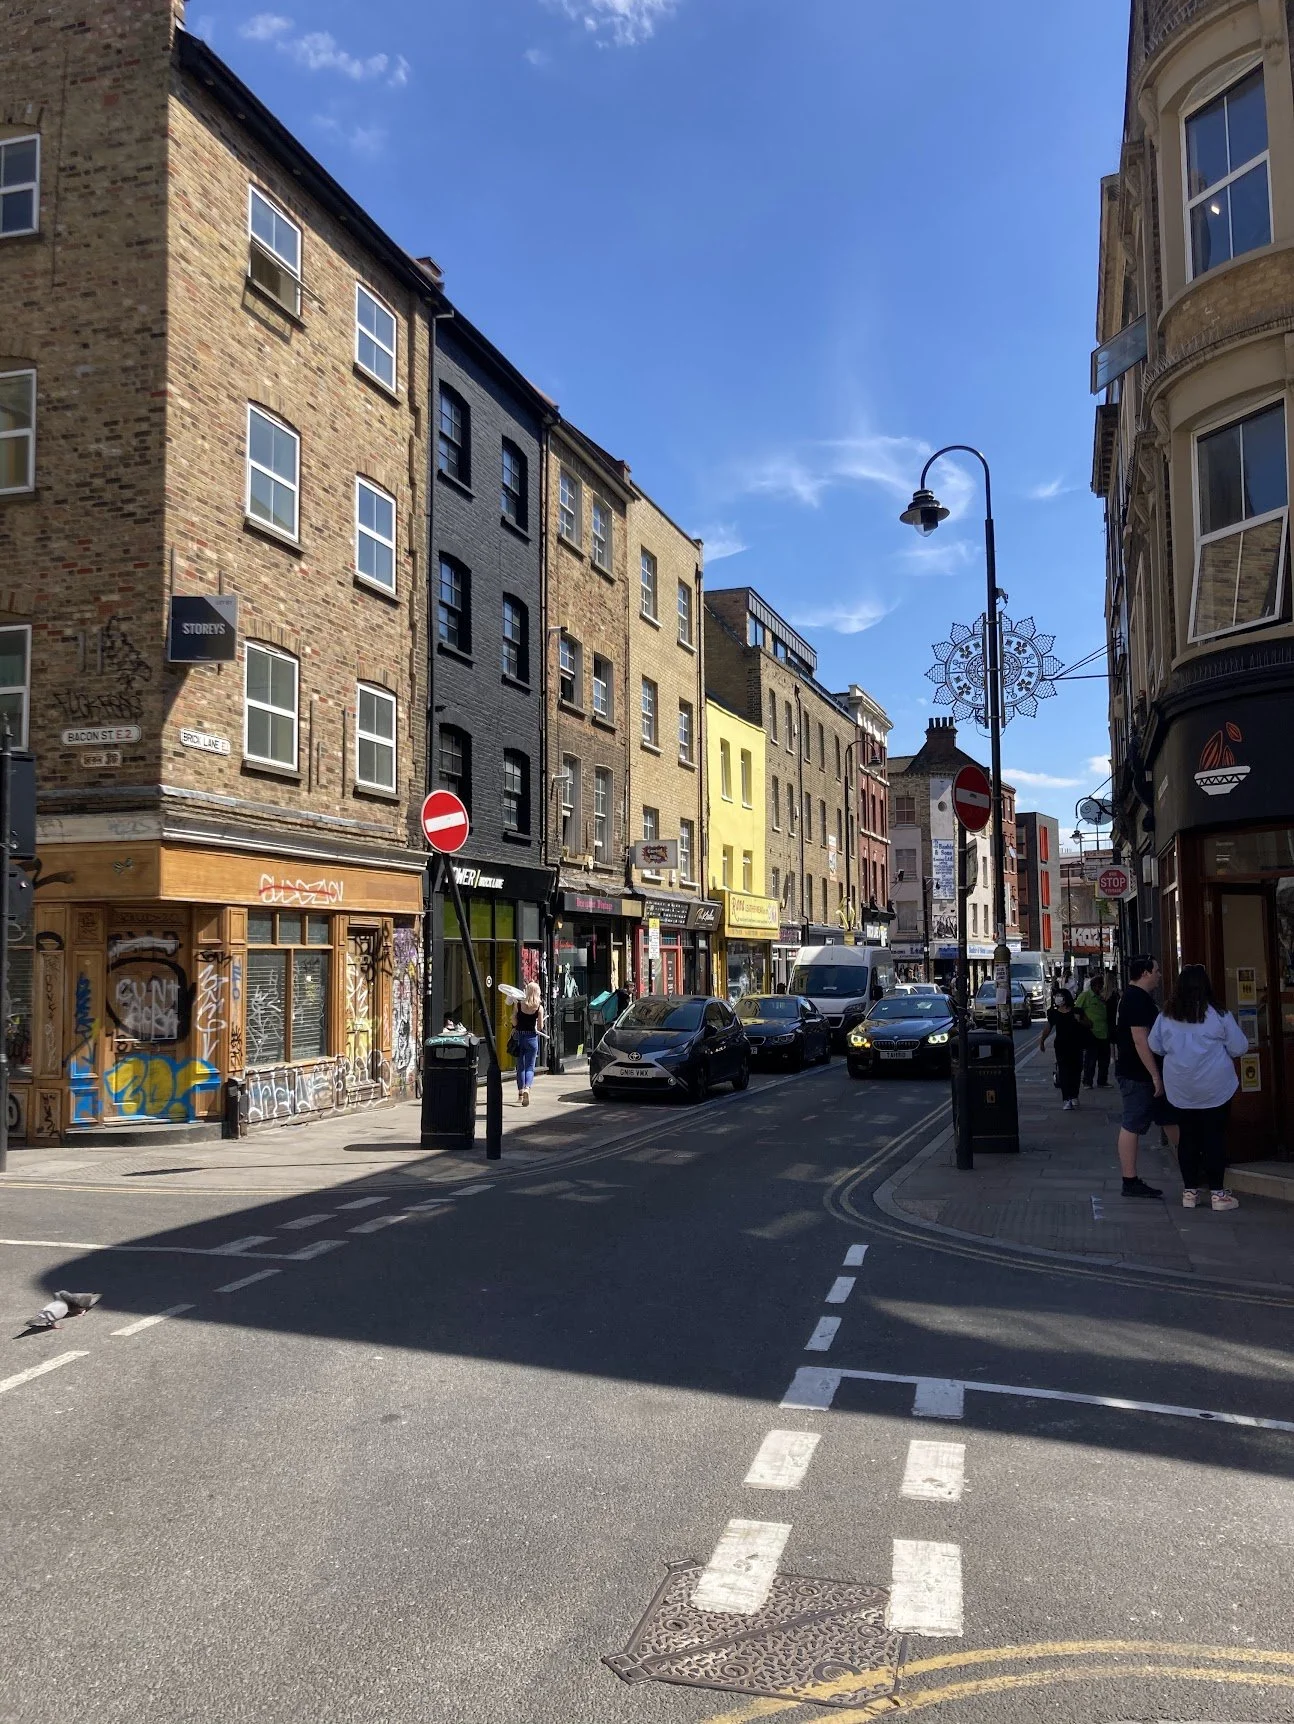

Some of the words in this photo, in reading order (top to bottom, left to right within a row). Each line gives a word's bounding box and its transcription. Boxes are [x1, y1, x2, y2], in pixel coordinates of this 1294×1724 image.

[182, 622, 226, 635] STOREYS
[68, 731, 99, 742] BACON
[183, 732, 201, 746] BRICK
[203, 737, 220, 750] LANE
[1100, 877, 1126, 888] STOP
